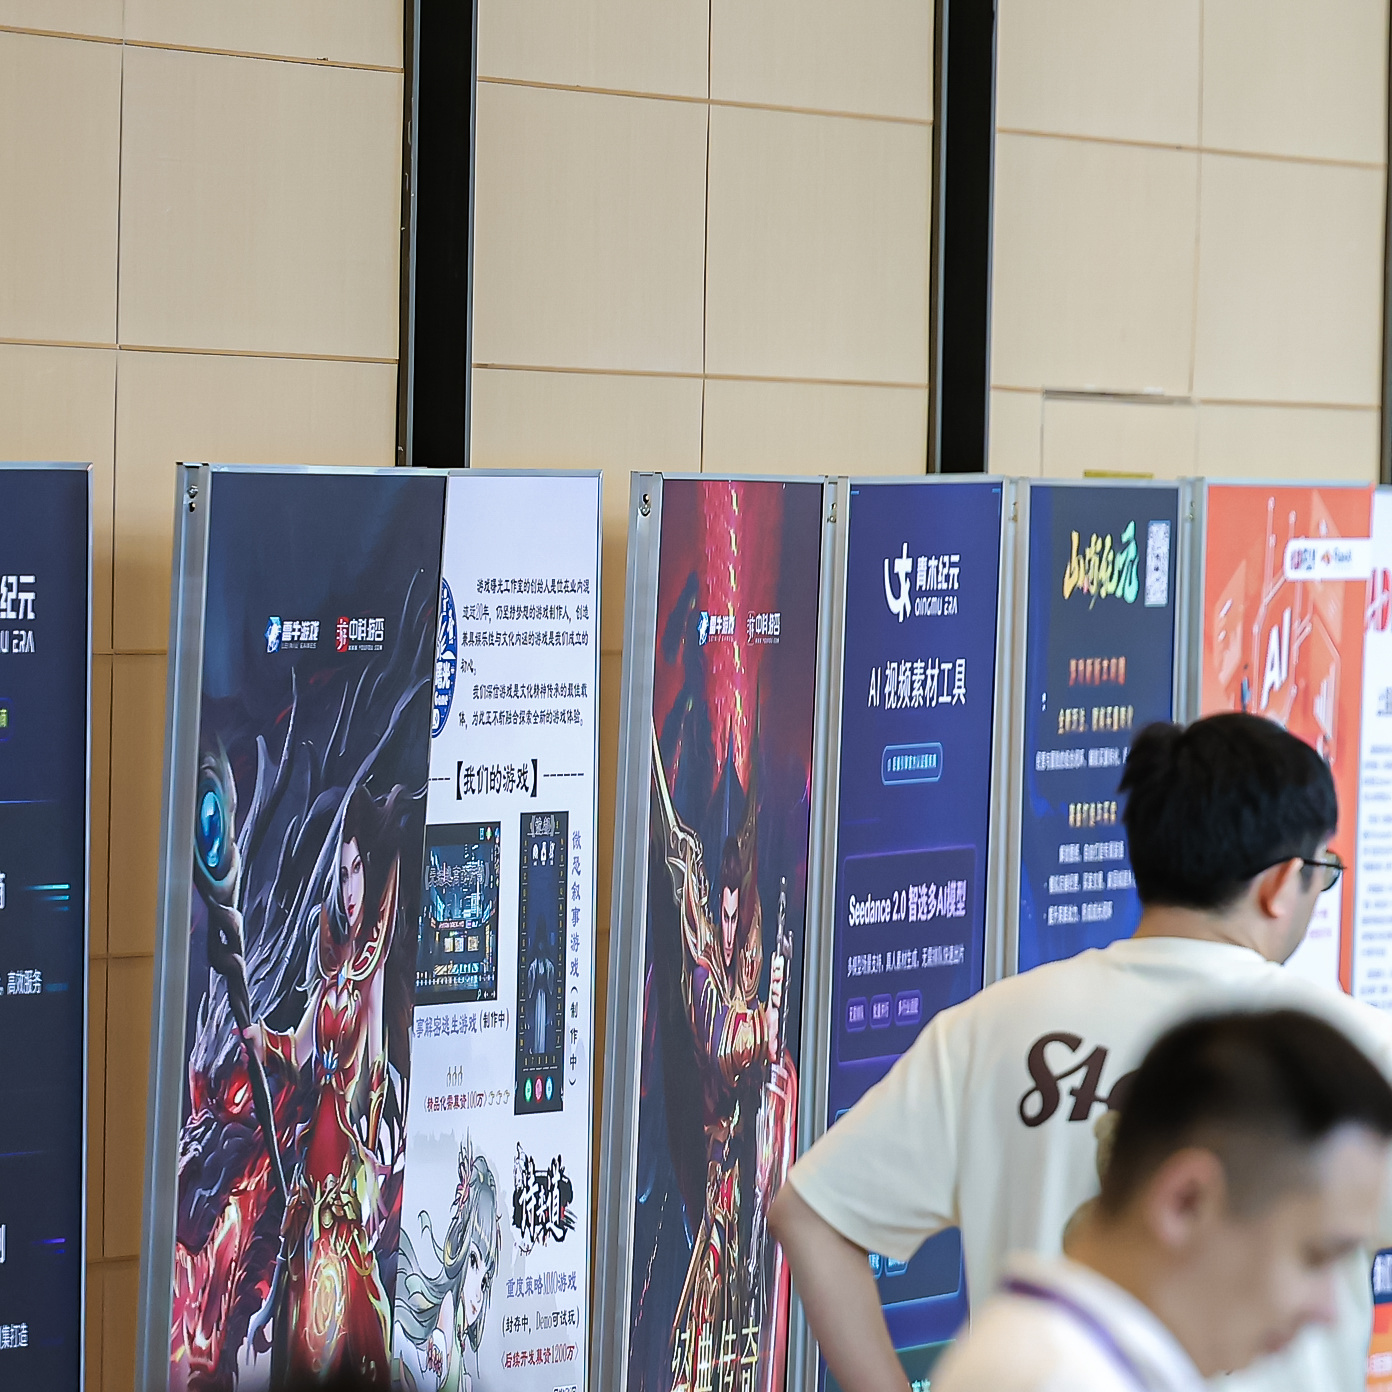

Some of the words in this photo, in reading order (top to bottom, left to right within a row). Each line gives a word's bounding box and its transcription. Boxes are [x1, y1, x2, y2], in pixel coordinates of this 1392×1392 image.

[916, 554, 961, 591] 青木纪元
[0, 574, 36, 620] 纪元
[12, 629, 36, 654] ERA
[281, 620, 320, 642] 雷牛游戏
[1260, 606, 1293, 711] AI
[867, 666, 882, 708] AI
[884, 657, 967, 711] 视频素材工具
[848, 893, 892, 928] Seedance
[891, 889, 907, 922] 2.0
[412, 1007, 510, 1040] 事解密逃生游戏（制作中）
